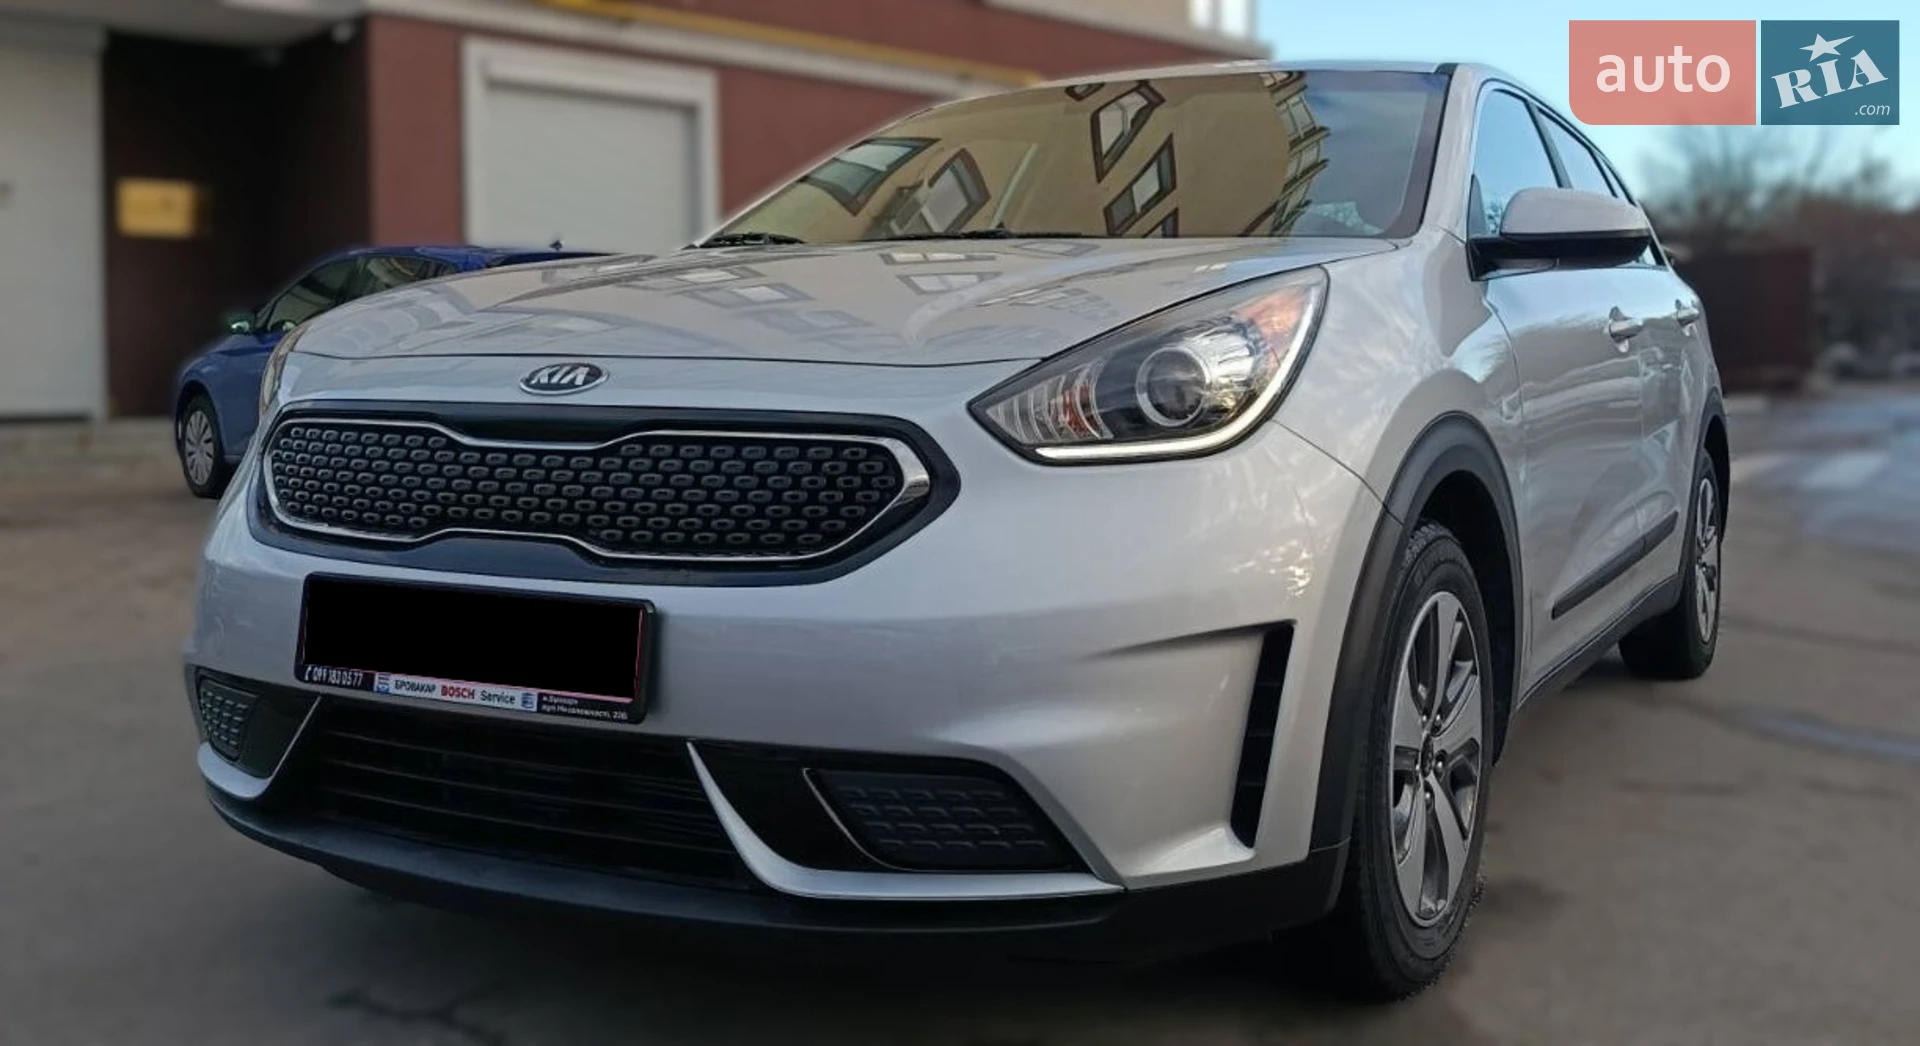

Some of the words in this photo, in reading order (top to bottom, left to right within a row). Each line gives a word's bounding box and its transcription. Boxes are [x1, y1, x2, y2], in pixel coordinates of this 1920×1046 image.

[529, 363, 590, 385] KIA
[440, 685, 475, 700] BOSCH
[480, 690, 516, 705] Service
